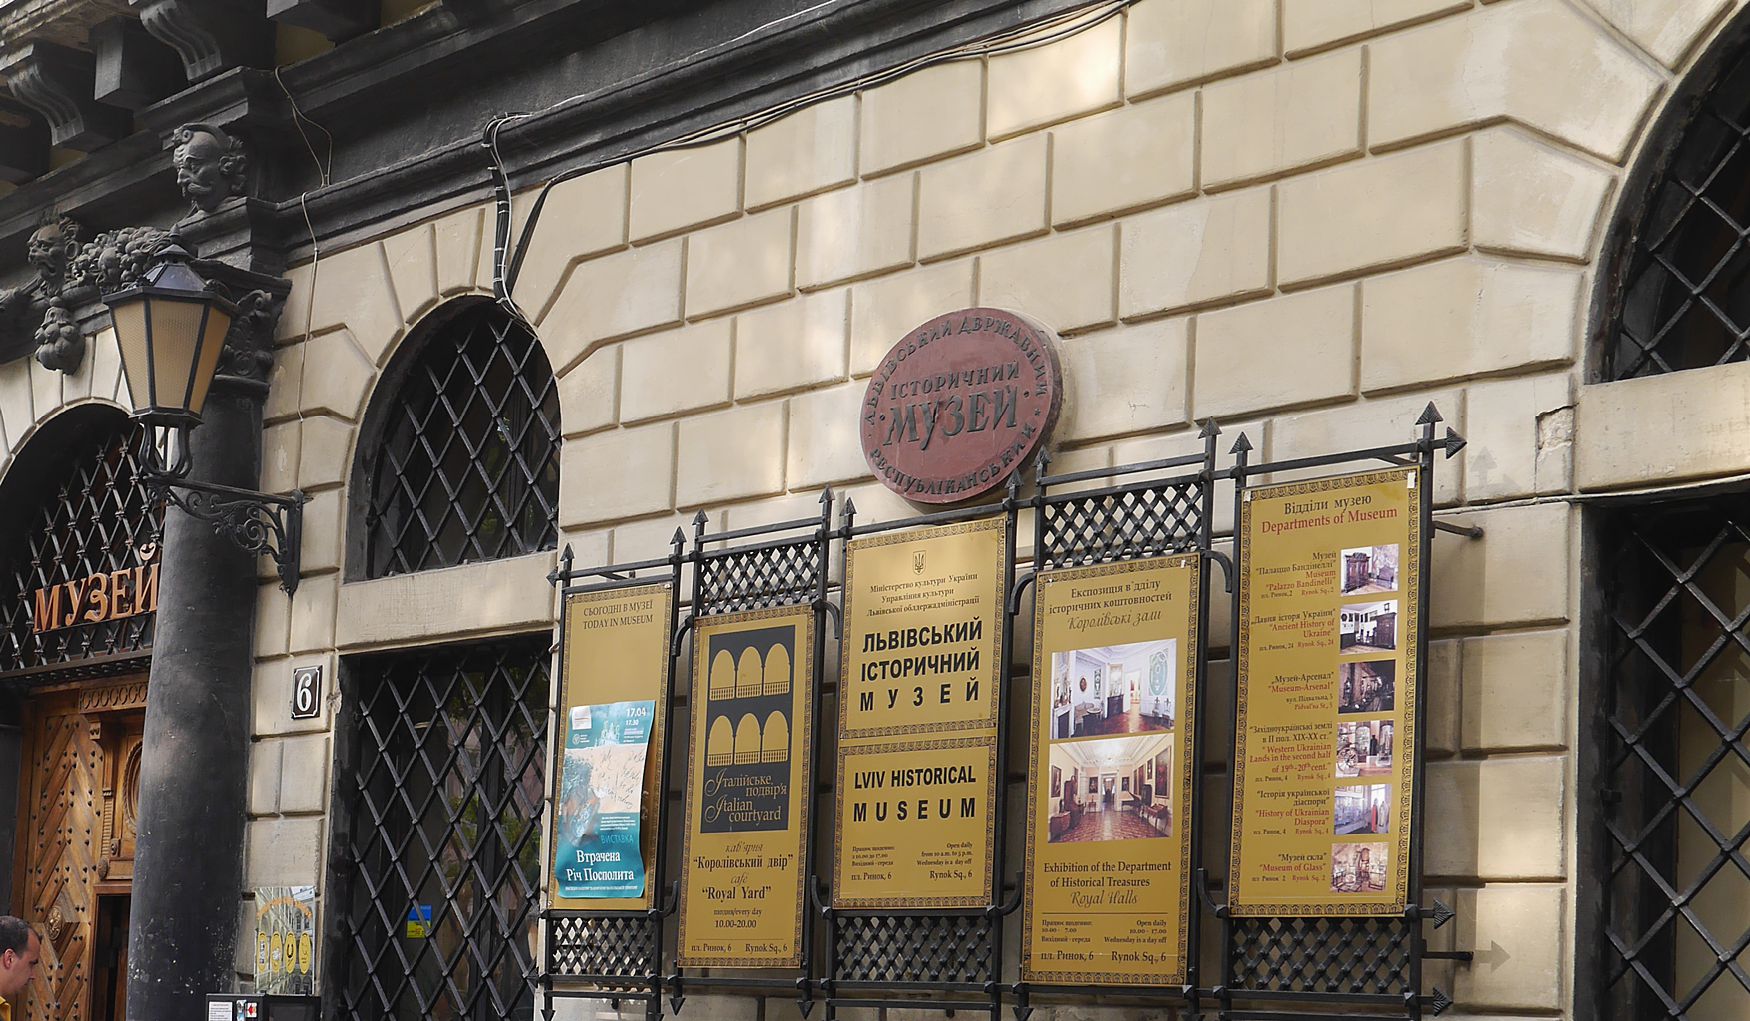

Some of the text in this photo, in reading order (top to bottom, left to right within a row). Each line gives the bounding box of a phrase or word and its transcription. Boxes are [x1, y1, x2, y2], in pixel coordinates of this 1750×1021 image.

[865, 316, 1047, 426] ЛЬВІВСЬКИЙ ДЕРЖАВНИЙ
[890, 360, 1020, 401] ІСТОРИЧНИЙ
[883, 385, 1018, 450] МУЗЕЙ
[870, 420, 1036, 495] РЕСПУБЛІКАНСЬКИЙ
[1284, 495, 1371, 515] Відділи музею
[1262, 507, 1398, 535] Departments of Museum
[1312, 552, 1337, 562] Музей
[1305, 570, 1336, 578] Museum
[33, 543, 160, 634] МУЗЕЙ
[870, 573, 978, 593] Міністерство культури України
[881, 588, 954, 604] Управління культури
[1071, 585, 1123, 599] Експозиція
[583, 599, 653, 616] СЬОГОДНІ В МУЗЕЇ
[867, 595, 980, 617] Львівської облдержадміністрації
[1049, 592, 1172, 615] історичних коштовностей
[583, 614, 653, 629] TODAY IN MUSEUM
[1067, 609, 1132, 632] Королівські
[1300, 620, 1325, 629] History
[862, 616, 982, 653] ЛЬВІВСЬКИЙ
[861, 646, 980, 682] ІСТОРИЧНИЙ
[297, 673, 312, 711] 6
[860, 676, 979, 712] МУЗЕЙ
[626, 707, 646, 717] 17.04
[1296, 743, 1332, 752] Ukrainian
[1249, 751, 1331, 763] Lands in the second half
[1271, 764, 1279, 773] of
[854, 765, 976, 789] LVIV HISTORICAL
[745, 783, 787, 799] подвір'я
[1287, 788, 1330, 799] української
[704, 794, 753, 823] Italian
[853, 797, 976, 822] MUSEUM
[1285, 809, 1293, 817] of
[1294, 808, 1330, 817] Ukrainian
[728, 806, 781, 826] courtyard
[960, 841, 973, 849] daily
[576, 850, 620, 865] Втрачена
[1044, 861, 1171, 874] Exhibition of the Department
[1294, 863, 1302, 871] of
[566, 868, 634, 881] Річ Посполита
[863, 873, 886, 881] Ринок,
[929, 869, 973, 881] Rynok Sq., 6
[1050, 877, 1150, 887] of Historical Treasures
[1070, 889, 1138, 908] Royal Halls
[752, 908, 762, 916] day
[715, 920, 757, 928] 10.00-20.00
[1152, 919, 1167, 927] daily
[1104, 936, 1135, 944] Wednesday
[1147, 936, 1157, 944] day
[703, 944, 726, 952] Ринок,
[745, 944, 767, 954] Rynok
[768, 944, 782, 955] Sq.,
[1057, 951, 1087, 961] Ринок,
[1089, 951, 1094, 960] 6
[1111, 951, 1140, 963] Rynok
[1161, 952, 1167, 961] 6
